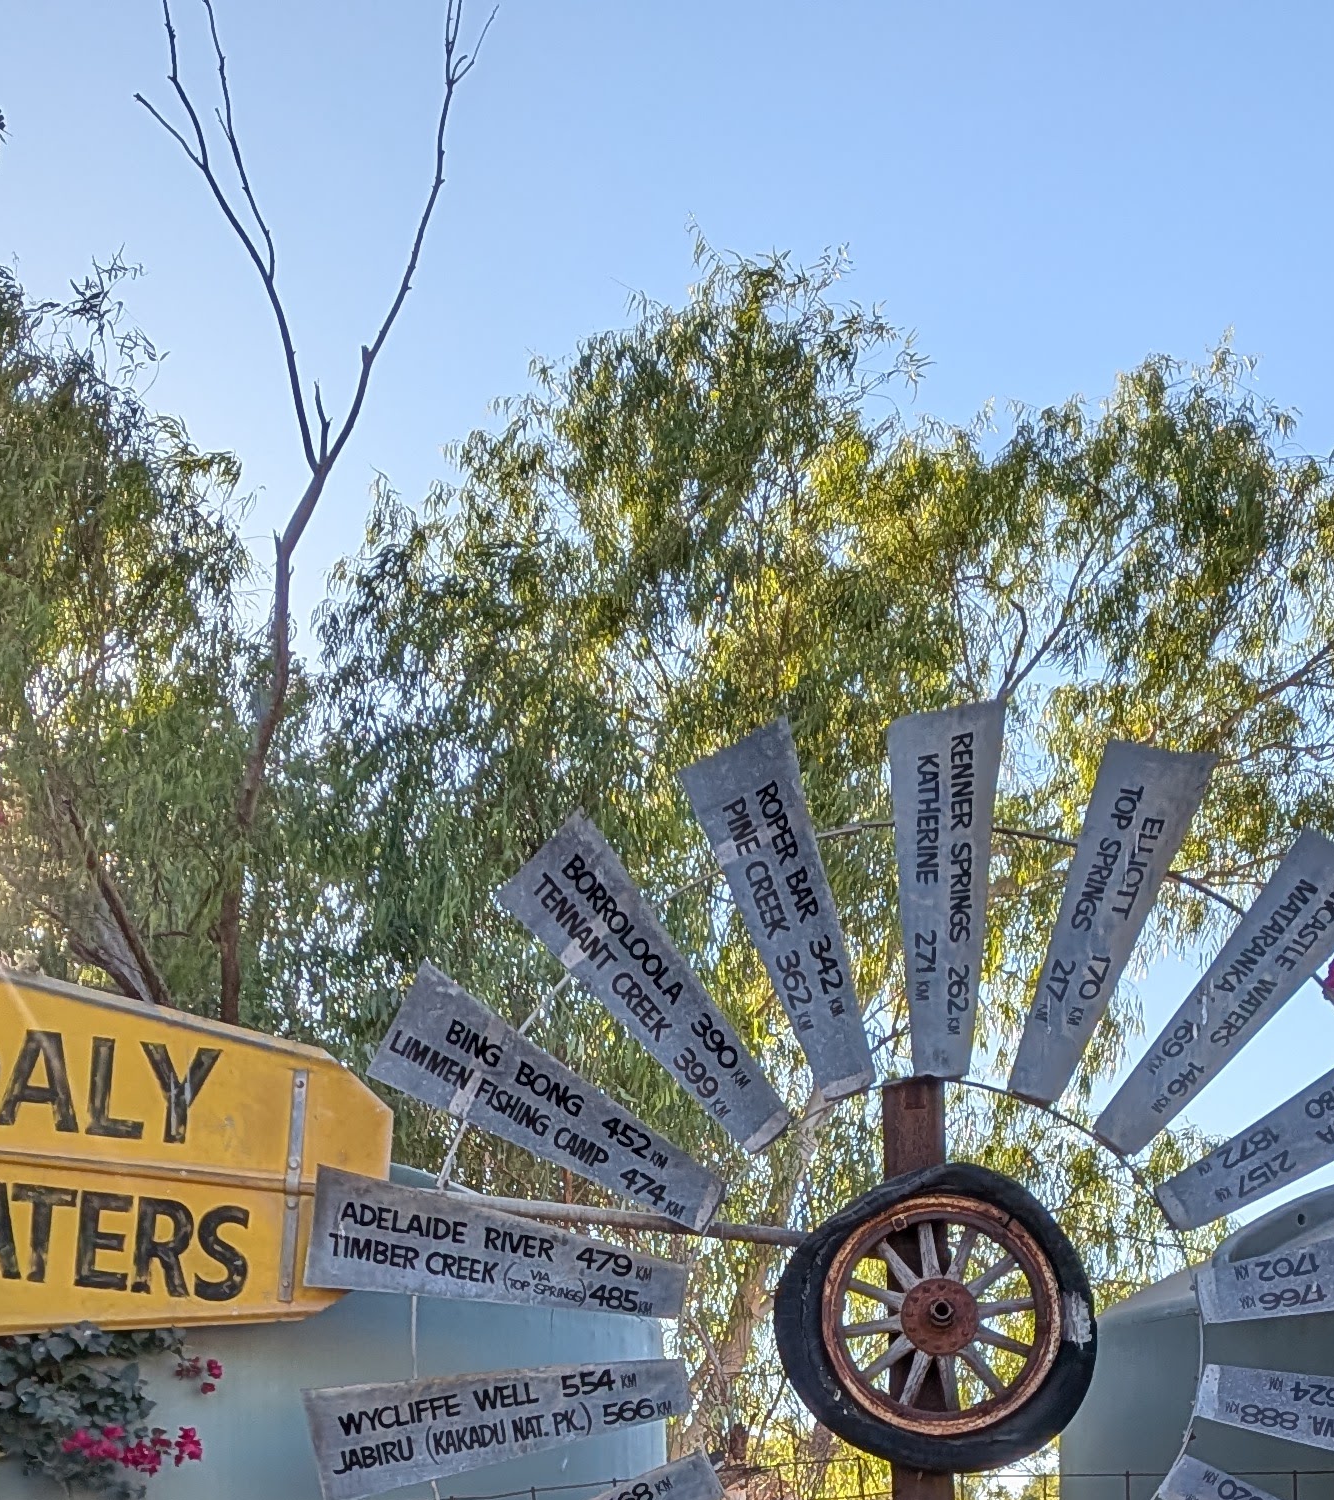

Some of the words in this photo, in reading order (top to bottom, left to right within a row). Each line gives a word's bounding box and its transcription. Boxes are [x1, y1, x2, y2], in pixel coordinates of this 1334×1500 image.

[950, 731, 975, 831] RENNER
[1110, 785, 1144, 831] TOP
[916, 753, 940, 886] KATHERINE
[722, 796, 761, 857] PINE
[745, 860, 791, 941] CREEK
[776, 949, 813, 1009] 362
[755, 779, 798, 866] ROPER
[785, 866, 819, 923] BAR
[809, 934, 844, 995] 342
[949, 842, 972, 943] SPRINGS
[1071, 836, 1121, 933] SPRINGS
[1111, 817, 1165, 921] ELLIOTT
[562, 854, 684, 1005] BORROLOOLA
[691, 1012, 738, 1069] 390
[915, 930, 936, 973] 271
[1214, 878, 1319, 992] MATARANKA
[533, 872, 619, 971] TENNANT
[612, 972, 673, 1042] CREEK
[673, 1047, 718, 1099] 399
[947, 964, 969, 1015] 262
[1045, 958, 1076, 1003] 217
[1077, 954, 1111, 1001] 170
[1210, 977, 1279, 1048] WATERS
[1162, 1018, 1202, 1059] 169
[446, 1019, 503, 1068] BING
[515, 1064, 585, 1117] BONG
[602, 1117, 651, 1159] 452
[1167, 1060, 1205, 1097] 146
[389, 1030, 474, 1090] LIMMEN
[475, 1078, 551, 1137] FISHING
[554, 1128, 609, 1167] CAMP
[619, 1168, 667, 1202] 474
[1216, 1125, 1281, 1169] 1872
[1237, 1149, 1297, 1198] 2157
[329, 1233, 419, 1270] TIMBER
[426, 1252, 498, 1284] CREEK
[589, 1286, 639, 1312] 485
[341, 1202, 467, 1243] ADELAIDE
[485, 1227, 555, 1261] RIVER
[576, 1247, 632, 1276] 479
[1254, 1253, 1320, 1283] 1702
[1258, 1282, 1327, 1312] 1766
[333, 1436, 413, 1475] JABIRU
[513, 1414, 549, 1442] NAT.
[603, 1398, 655, 1425] 566
[338, 1393, 461, 1437] WYCLIFFE
[473, 1383, 540, 1412] WELL
[561, 1369, 616, 1398] 554
[1239, 1402, 1301, 1430] 888
